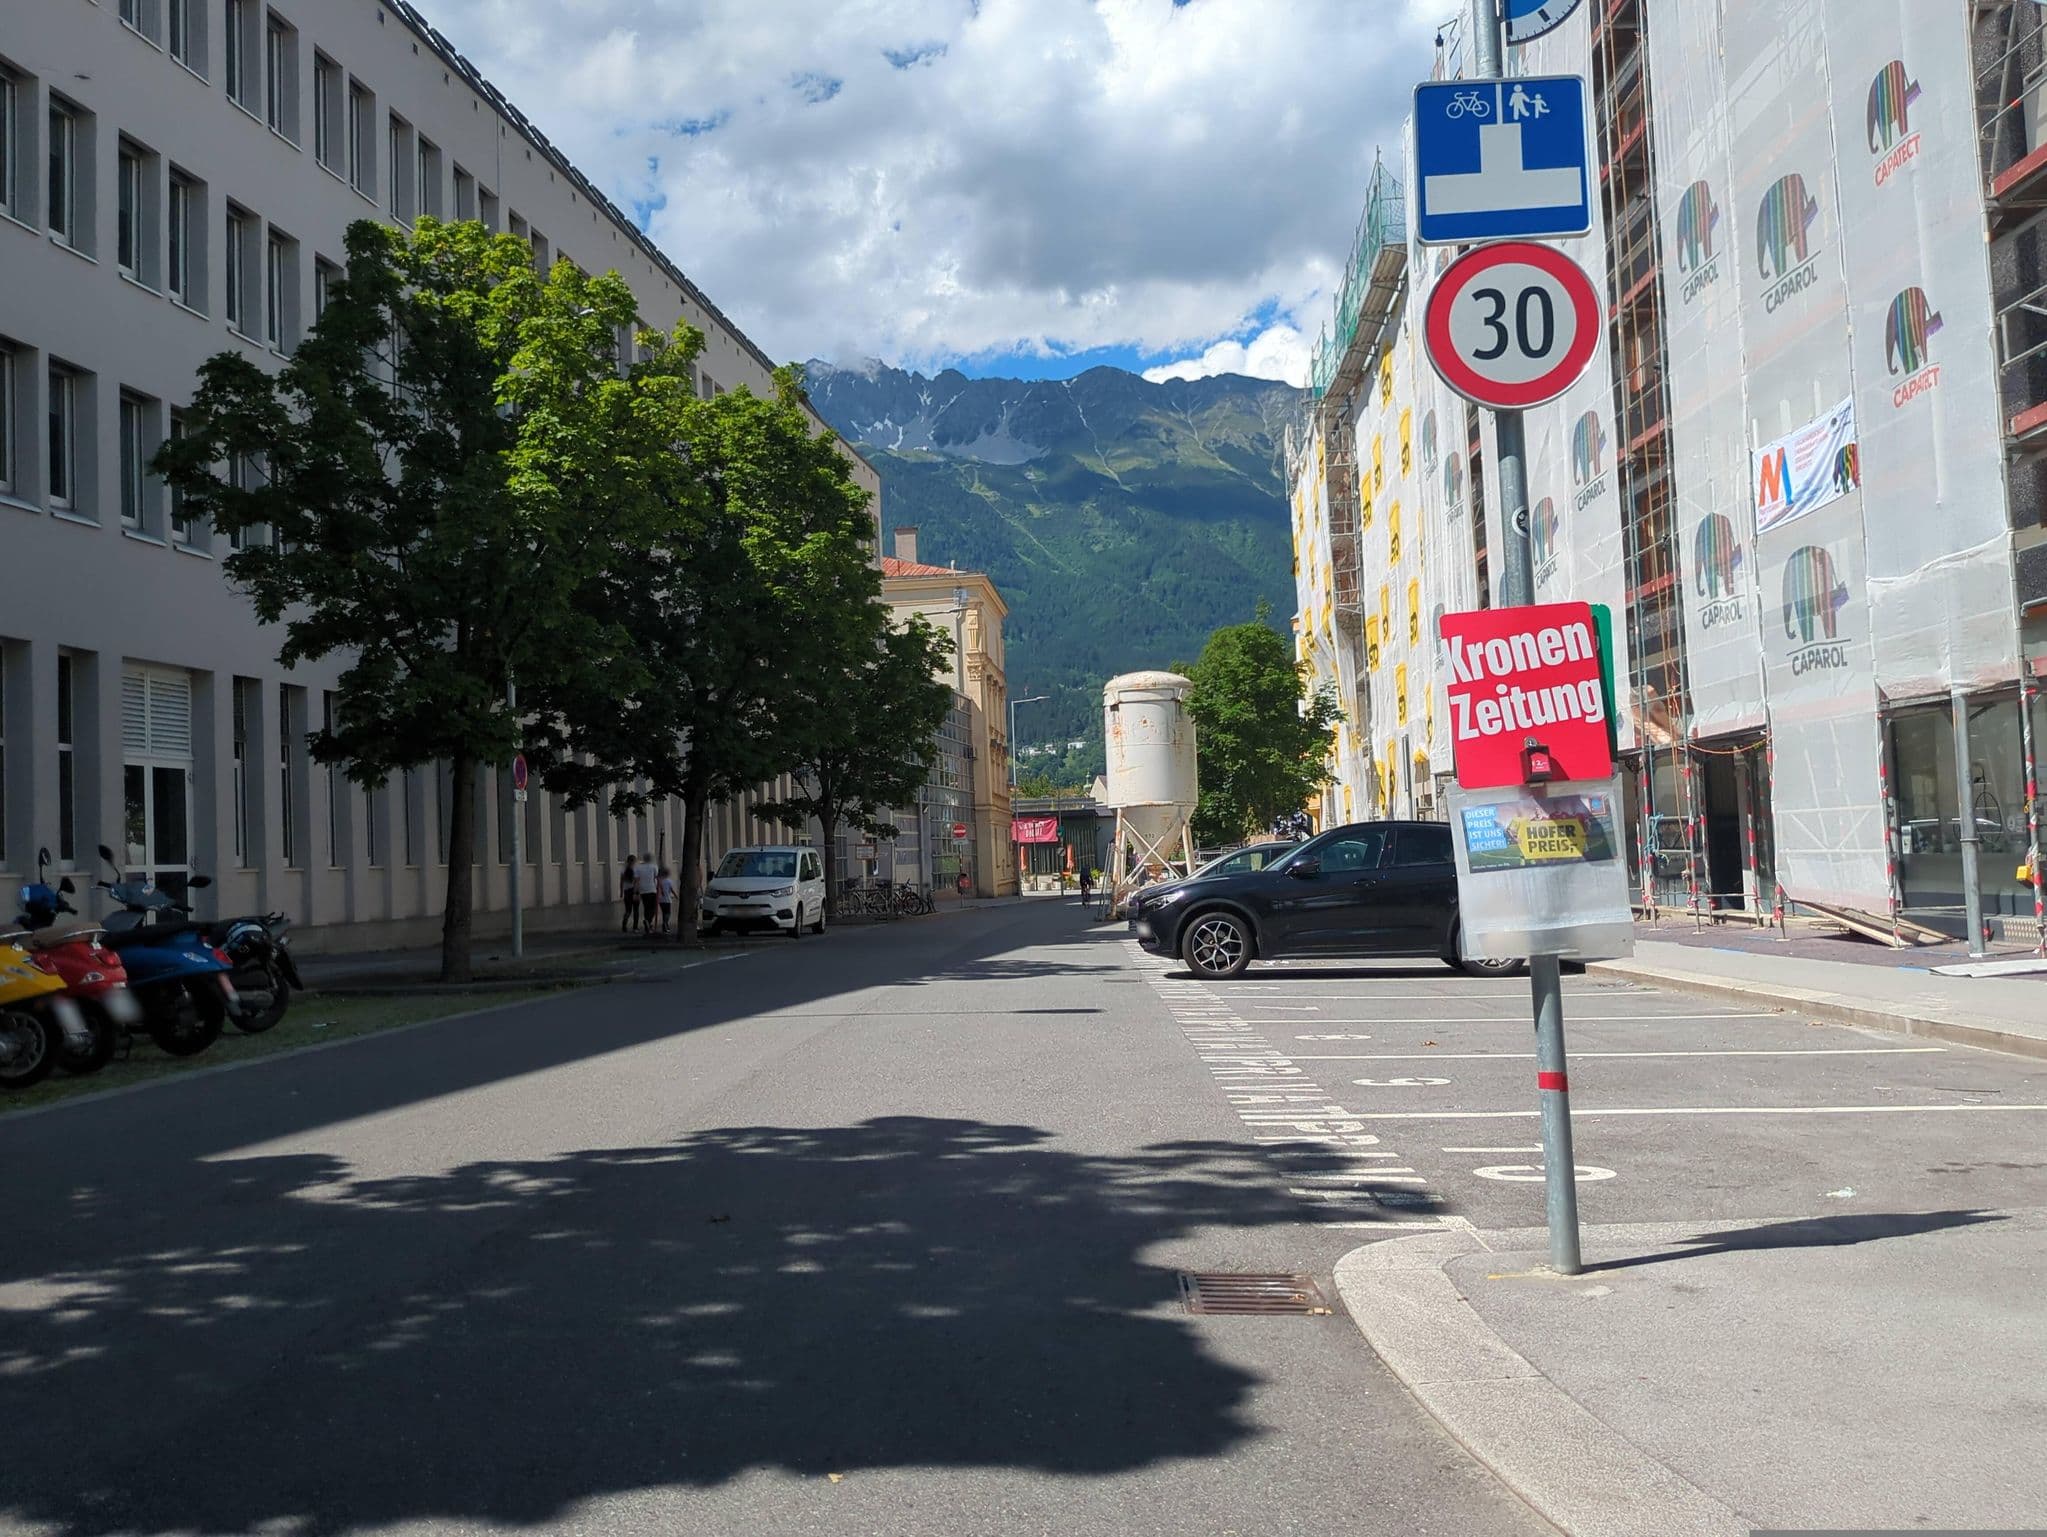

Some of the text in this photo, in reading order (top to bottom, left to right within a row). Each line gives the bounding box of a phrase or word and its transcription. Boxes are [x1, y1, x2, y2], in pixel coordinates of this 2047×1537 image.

[1875, 134, 1920, 187] CAPATECT
[1683, 261, 1719, 305] CAPAROL
[1765, 262, 1818, 314] CAPAROL
[1471, 286, 1554, 361] 30
[1577, 480, 1606, 511] CAPAROL
[1702, 600, 1742, 630] CAPAROL
[1441, 622, 1593, 685] Kronen
[1792, 646, 1848, 676] CAPAROL
[1450, 679, 1605, 741] Zeitung
[1466, 807, 1496, 819] DIESER
[1468, 818, 1493, 829] PREIS
[1470, 829, 1503, 839] IST UNS
[1526, 824, 1576, 840] HOFER
[1203, 1058, 1350, 1115] PRIVAT
[1351, 1077, 1452, 1087] 9
[1245, 1120, 1479, 1232] PRIVAT
